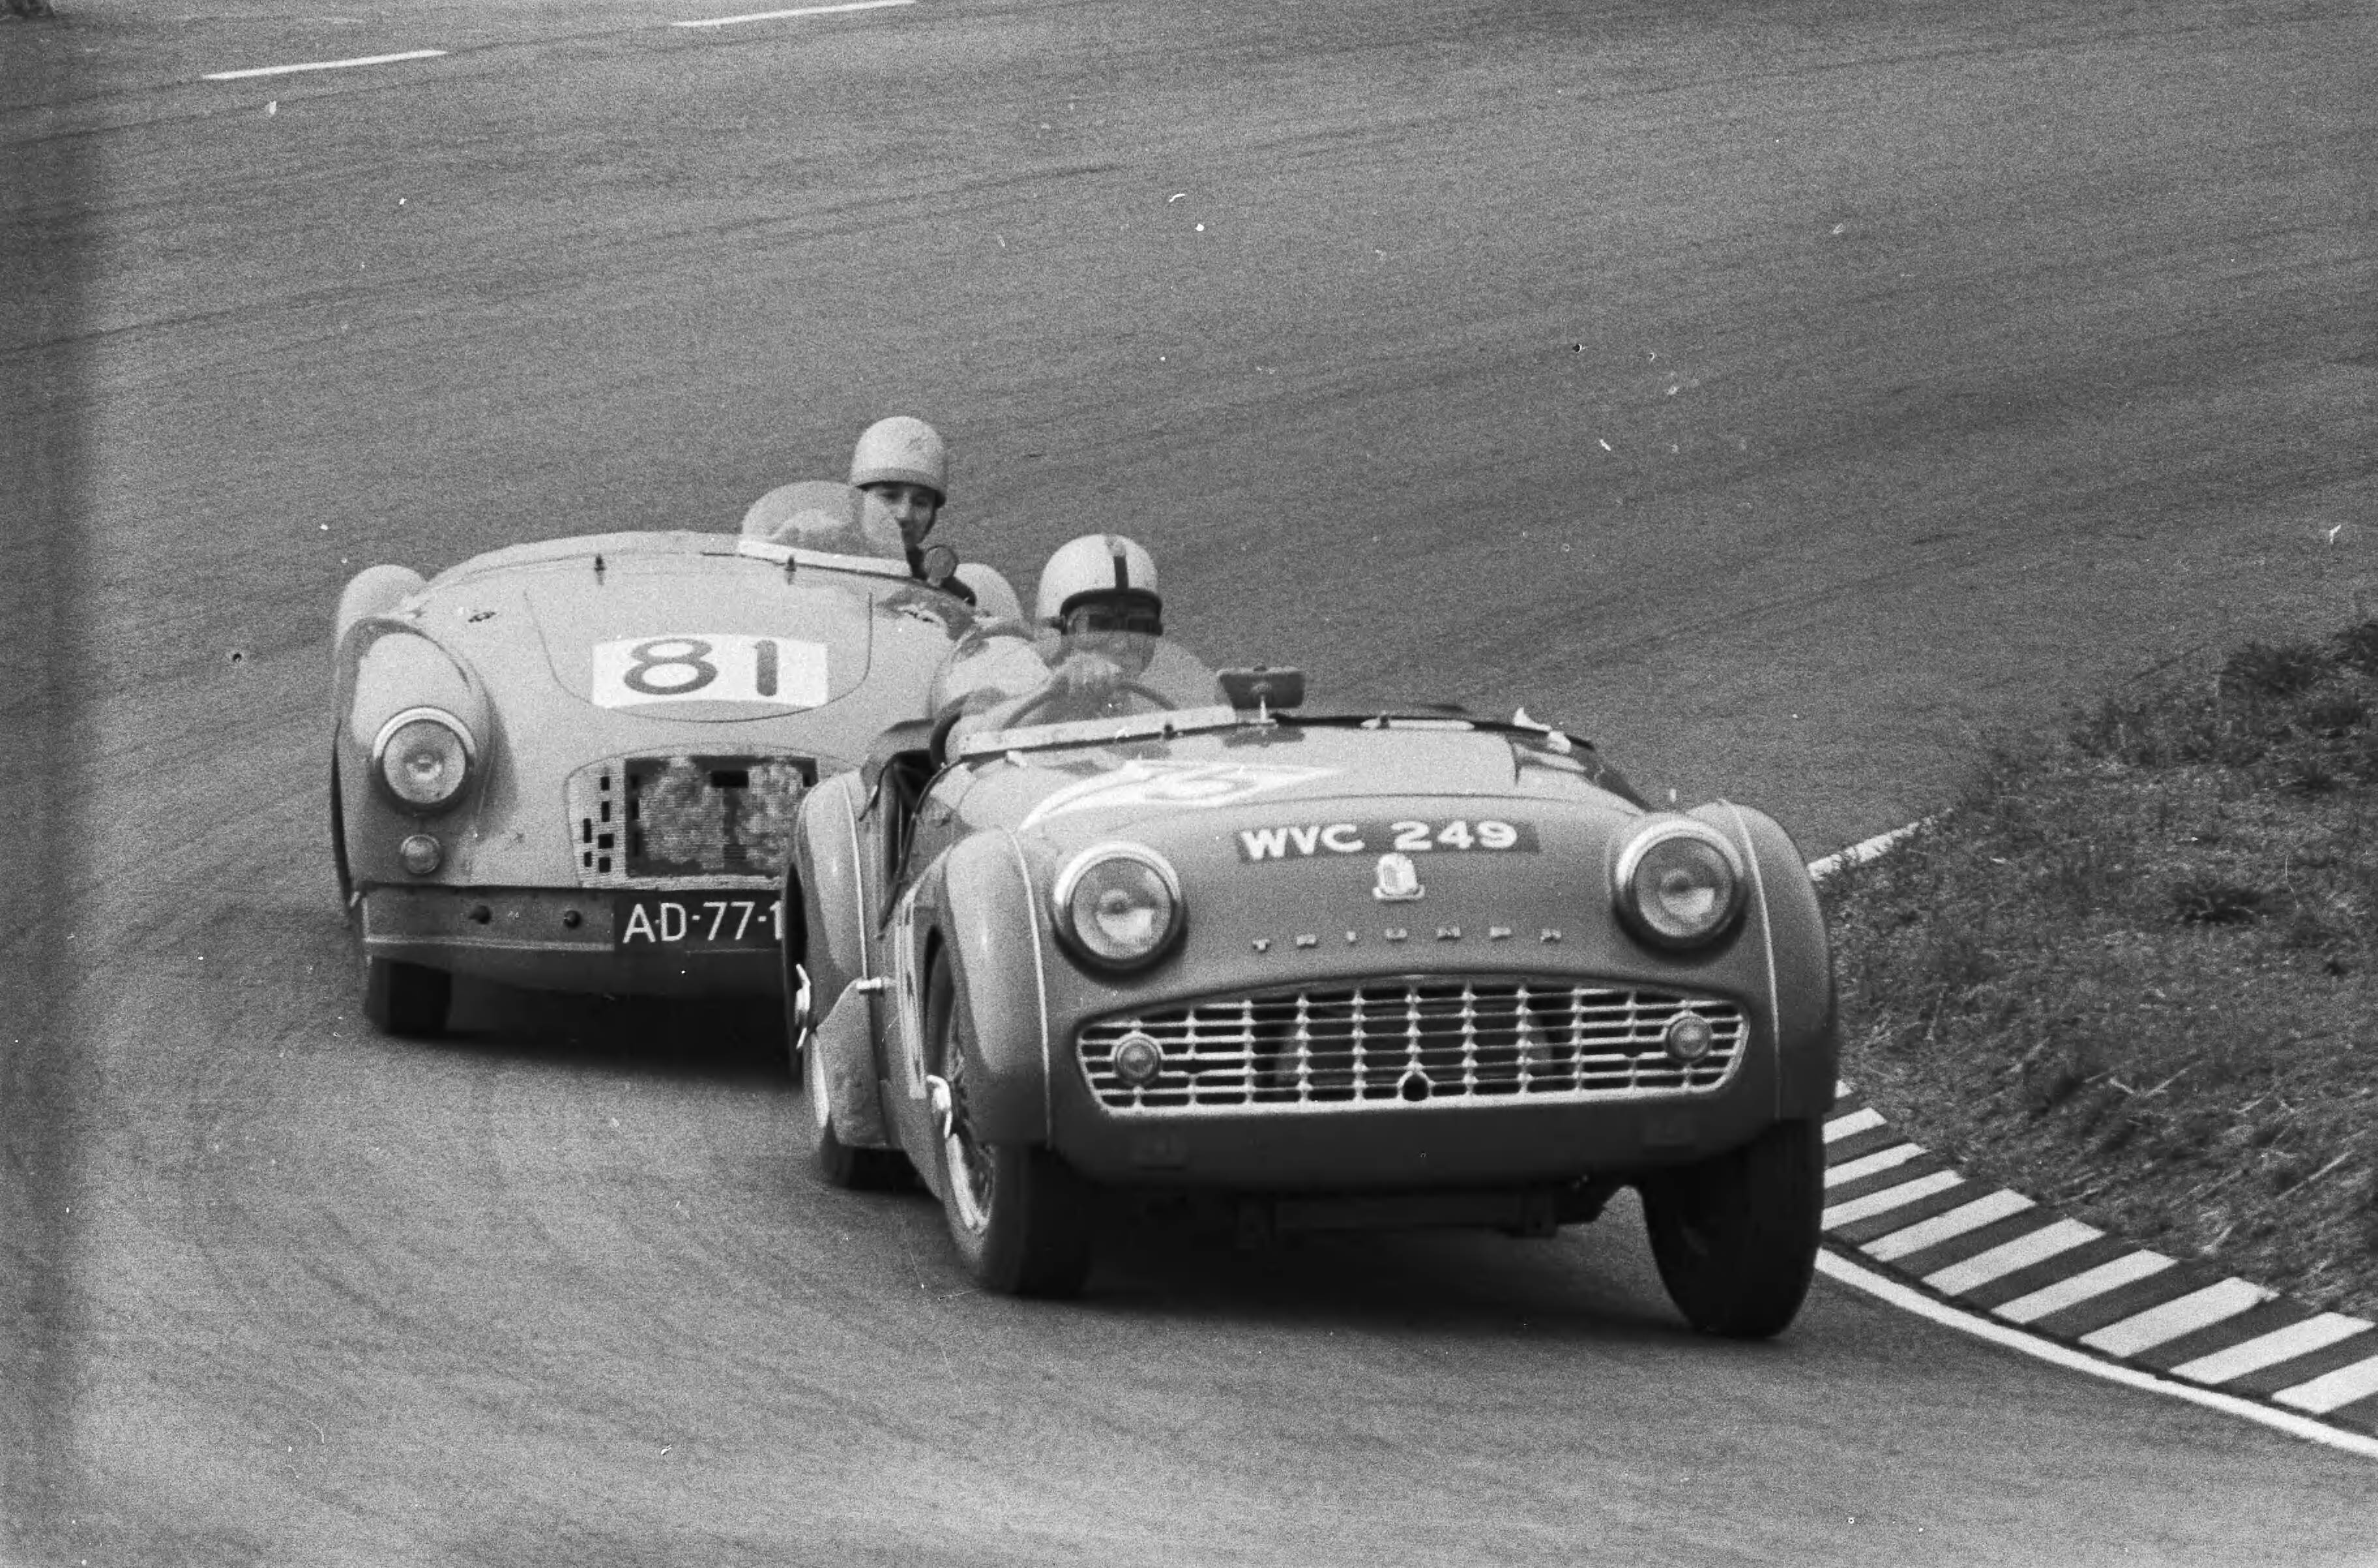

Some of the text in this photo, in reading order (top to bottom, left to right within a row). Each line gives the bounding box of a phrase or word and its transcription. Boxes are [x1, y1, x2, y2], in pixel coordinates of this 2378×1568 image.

[623, 638, 778, 697] 81
[1241, 820, 1518, 860] WVC 249
